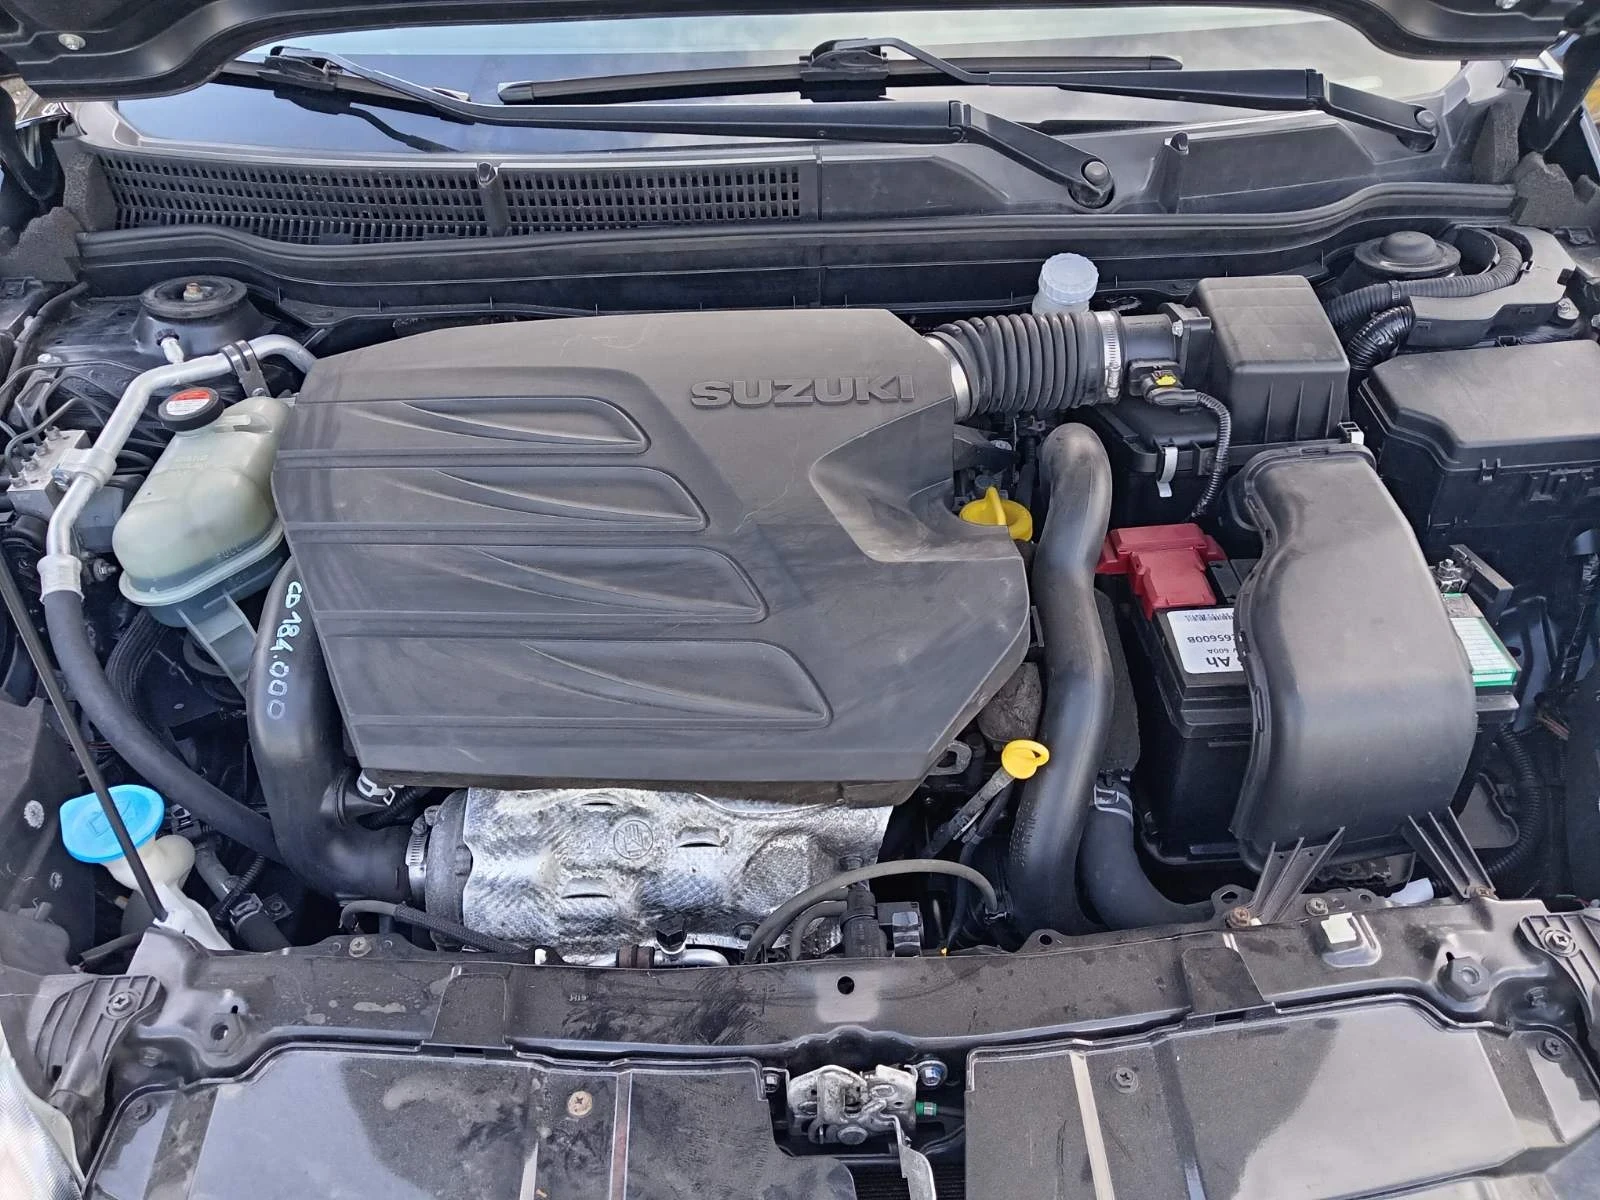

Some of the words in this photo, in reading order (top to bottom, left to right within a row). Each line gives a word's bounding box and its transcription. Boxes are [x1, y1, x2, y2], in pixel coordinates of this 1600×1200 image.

[690, 375, 915, 408] SUZUKI
[267, 611, 302, 720] 184.000
[1206, 656, 1230, 667] Ah
